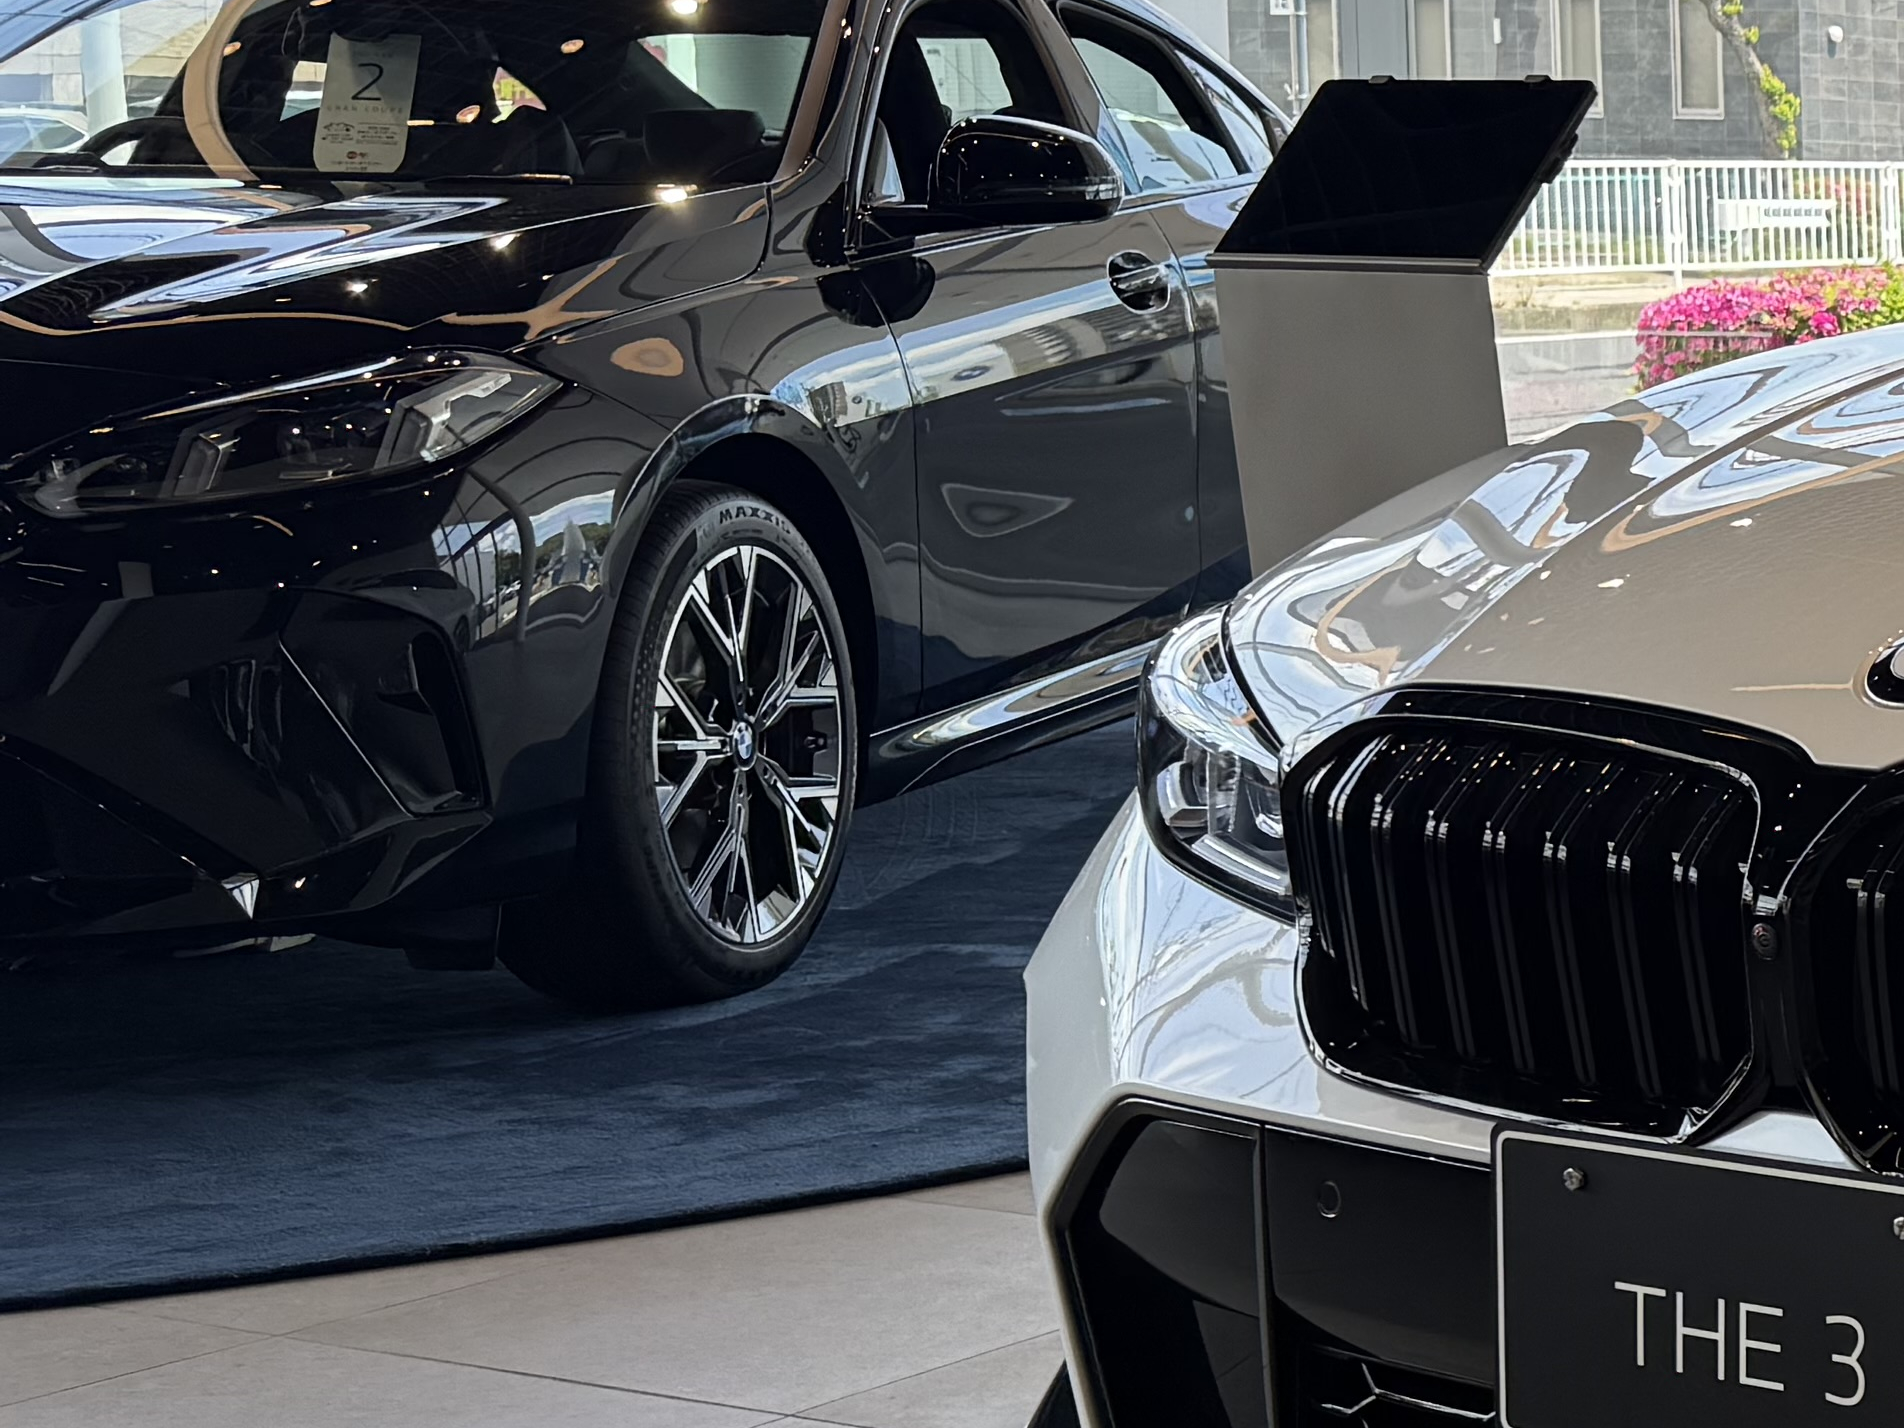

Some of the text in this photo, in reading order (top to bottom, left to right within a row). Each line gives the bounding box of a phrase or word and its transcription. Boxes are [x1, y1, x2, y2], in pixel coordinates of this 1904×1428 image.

[351, 62, 384, 101] 2
[1613, 1280, 1867, 1407] THE 3
